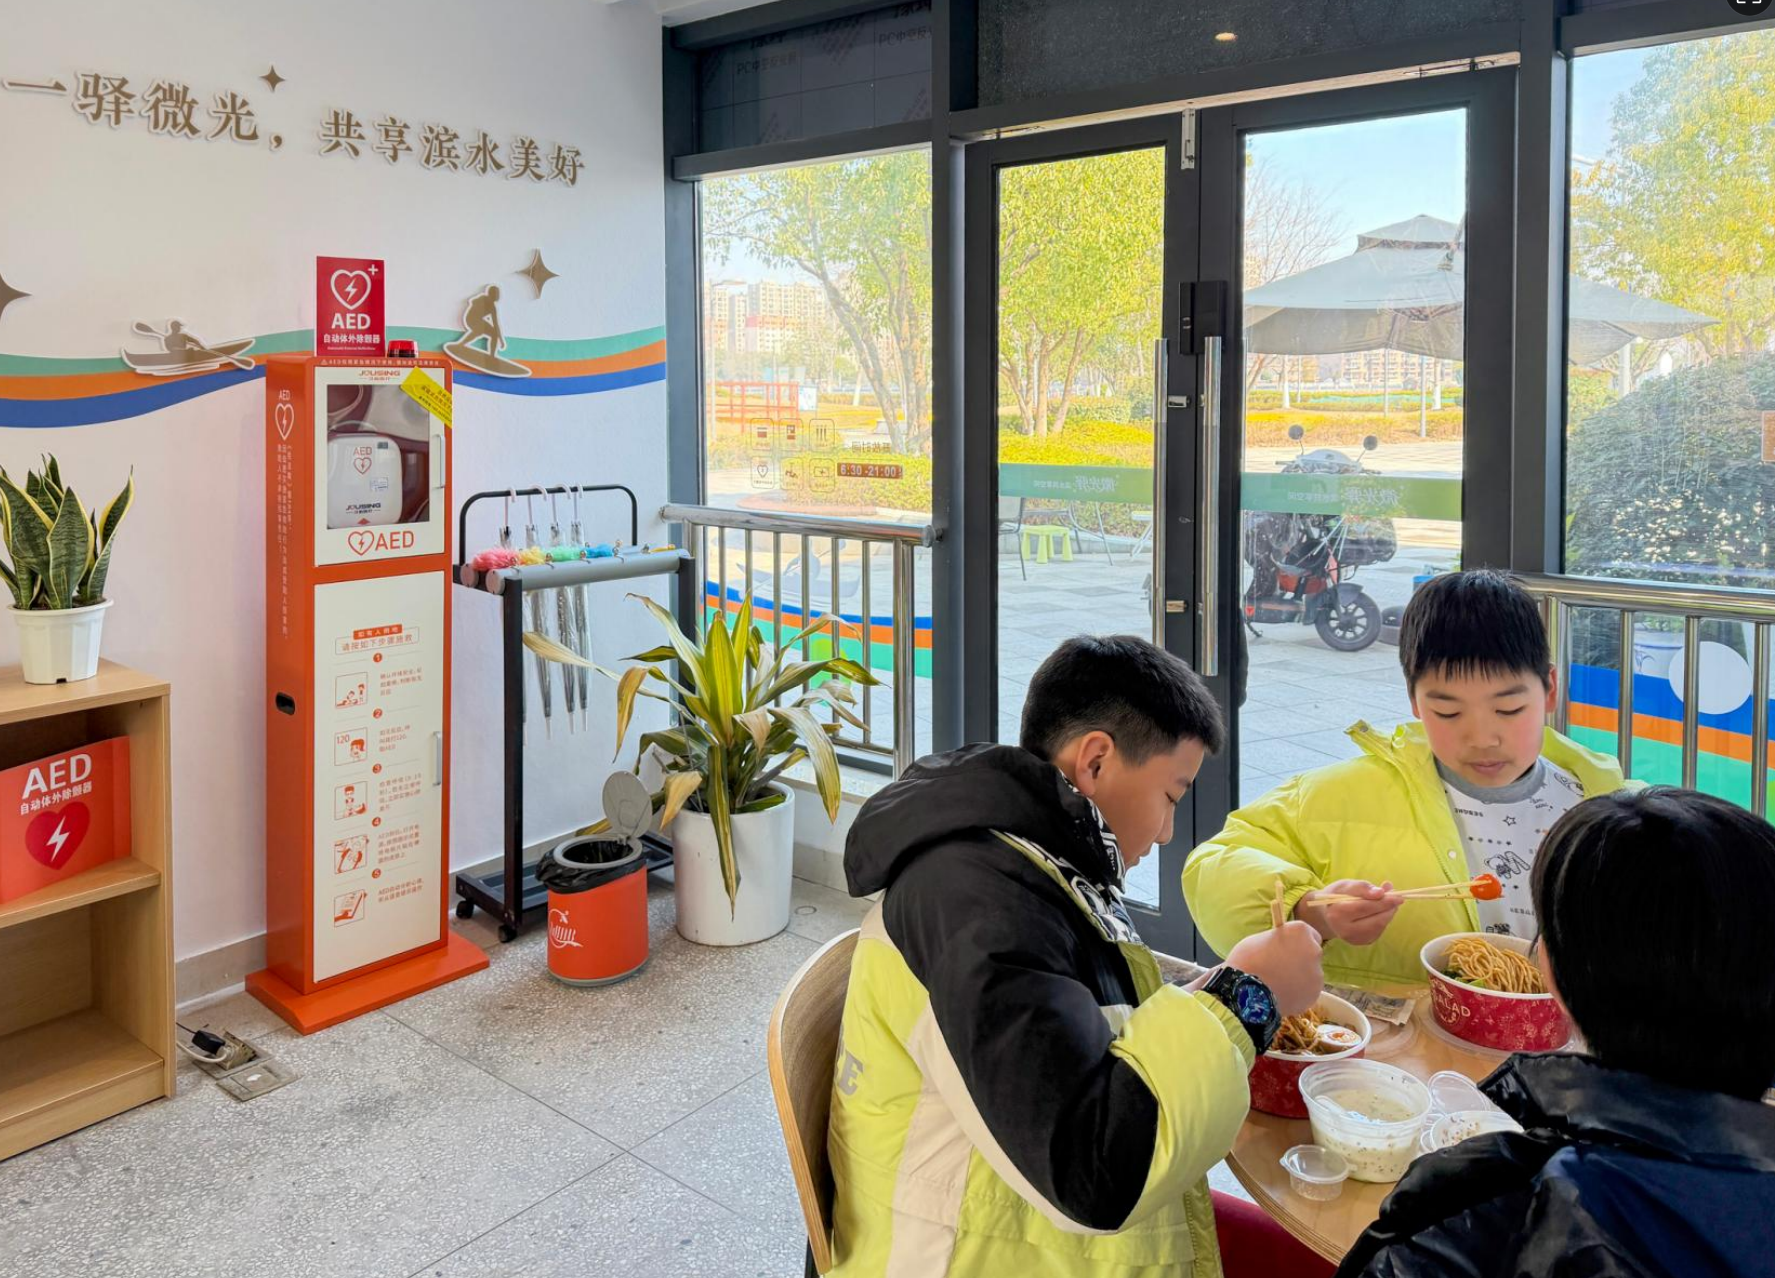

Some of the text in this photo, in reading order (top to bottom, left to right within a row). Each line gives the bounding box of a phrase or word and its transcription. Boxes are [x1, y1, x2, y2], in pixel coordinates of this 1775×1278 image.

[331, 312, 371, 330] AED
[279, 389, 291, 401] AED
[353, 446, 373, 456] AED
[375, 530, 414, 551] AED
[336, 733, 350, 744] 120
[21, 753, 92, 800] AED
[20, 780, 93, 816] 自动体外除颤器
